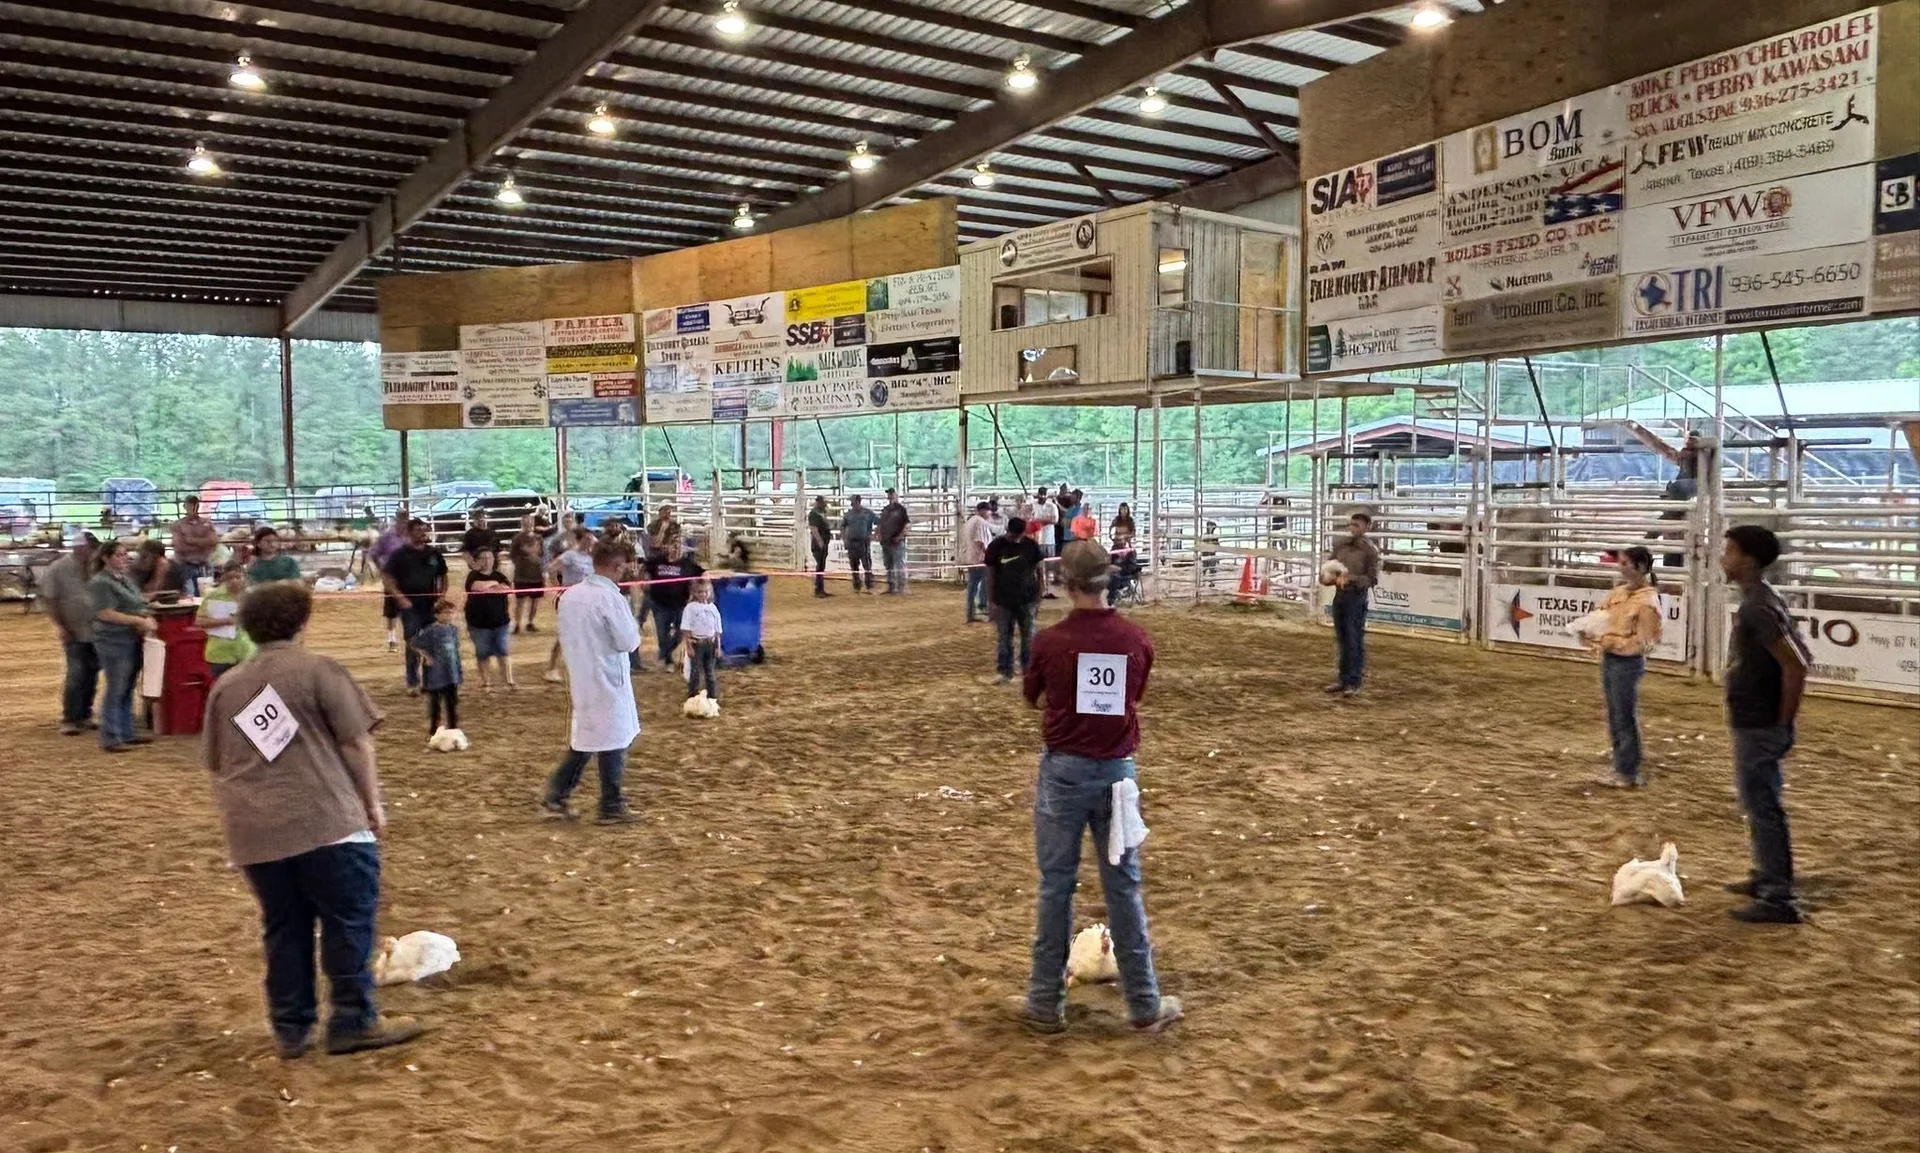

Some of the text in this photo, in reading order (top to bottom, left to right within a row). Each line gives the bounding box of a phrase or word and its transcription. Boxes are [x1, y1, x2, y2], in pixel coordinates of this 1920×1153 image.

[1680, 54, 1739, 85] PERRY
[1747, 13, 1874, 66] CHEVROLET
[1697, 72, 1756, 102] PERRY
[1763, 40, 1869, 86] KAWASAKI
[1503, 109, 1584, 159] BOM
[1549, 141, 1583, 162] Bank
[1658, 134, 1709, 166] FEW
[1311, 170, 1358, 215] SIA
[1668, 190, 1765, 231] VFW
[1671, 262, 1861, 311] TRI 936-545-6650
[554, 317, 624, 330] PARKER
[786, 322, 822, 346] SSB
[714, 357, 780, 375] KEITH'S
[1537, 597, 1598, 614] TEXAS FA
[1089, 666, 1116, 687] 30
[253, 703, 279, 731] 90
